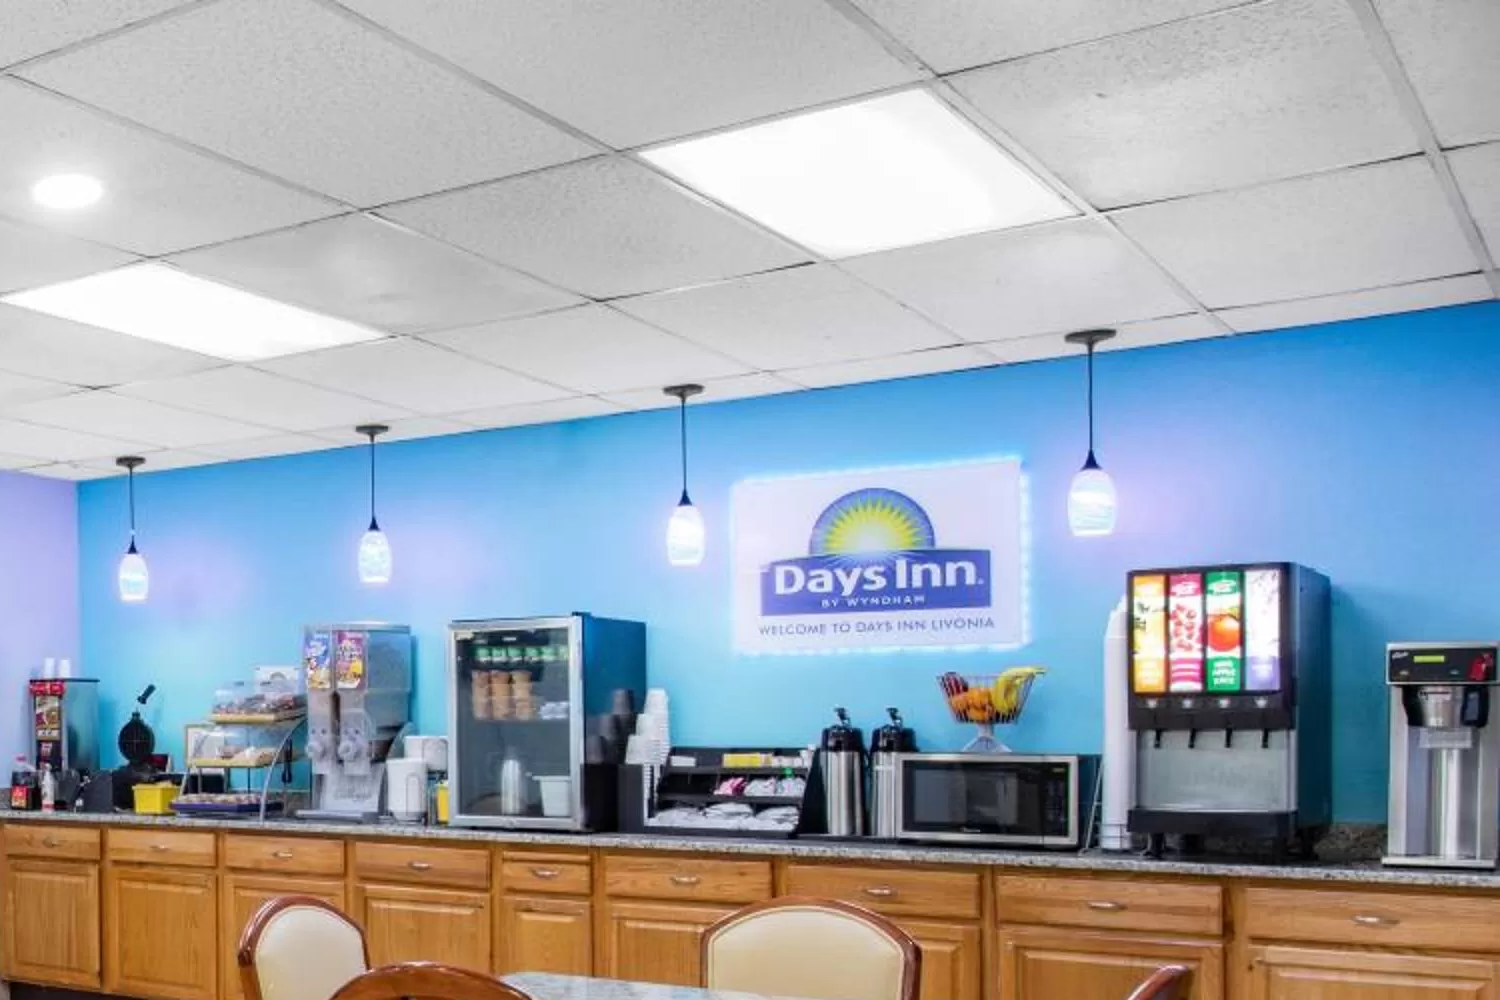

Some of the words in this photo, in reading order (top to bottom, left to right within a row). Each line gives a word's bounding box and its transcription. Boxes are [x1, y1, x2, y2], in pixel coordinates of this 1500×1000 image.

[774, 564, 887, 596] Days
[895, 559, 976, 588] Inn
[821, 599, 838, 608] BY
[847, 595, 925, 607] WYNDHAM
[758, 623, 825, 636] WELCOME
[832, 622, 851, 633] TO
[855, 621, 893, 633] DAYS
[897, 619, 926, 631] INN
[931, 616, 995, 630] LIVONIA
